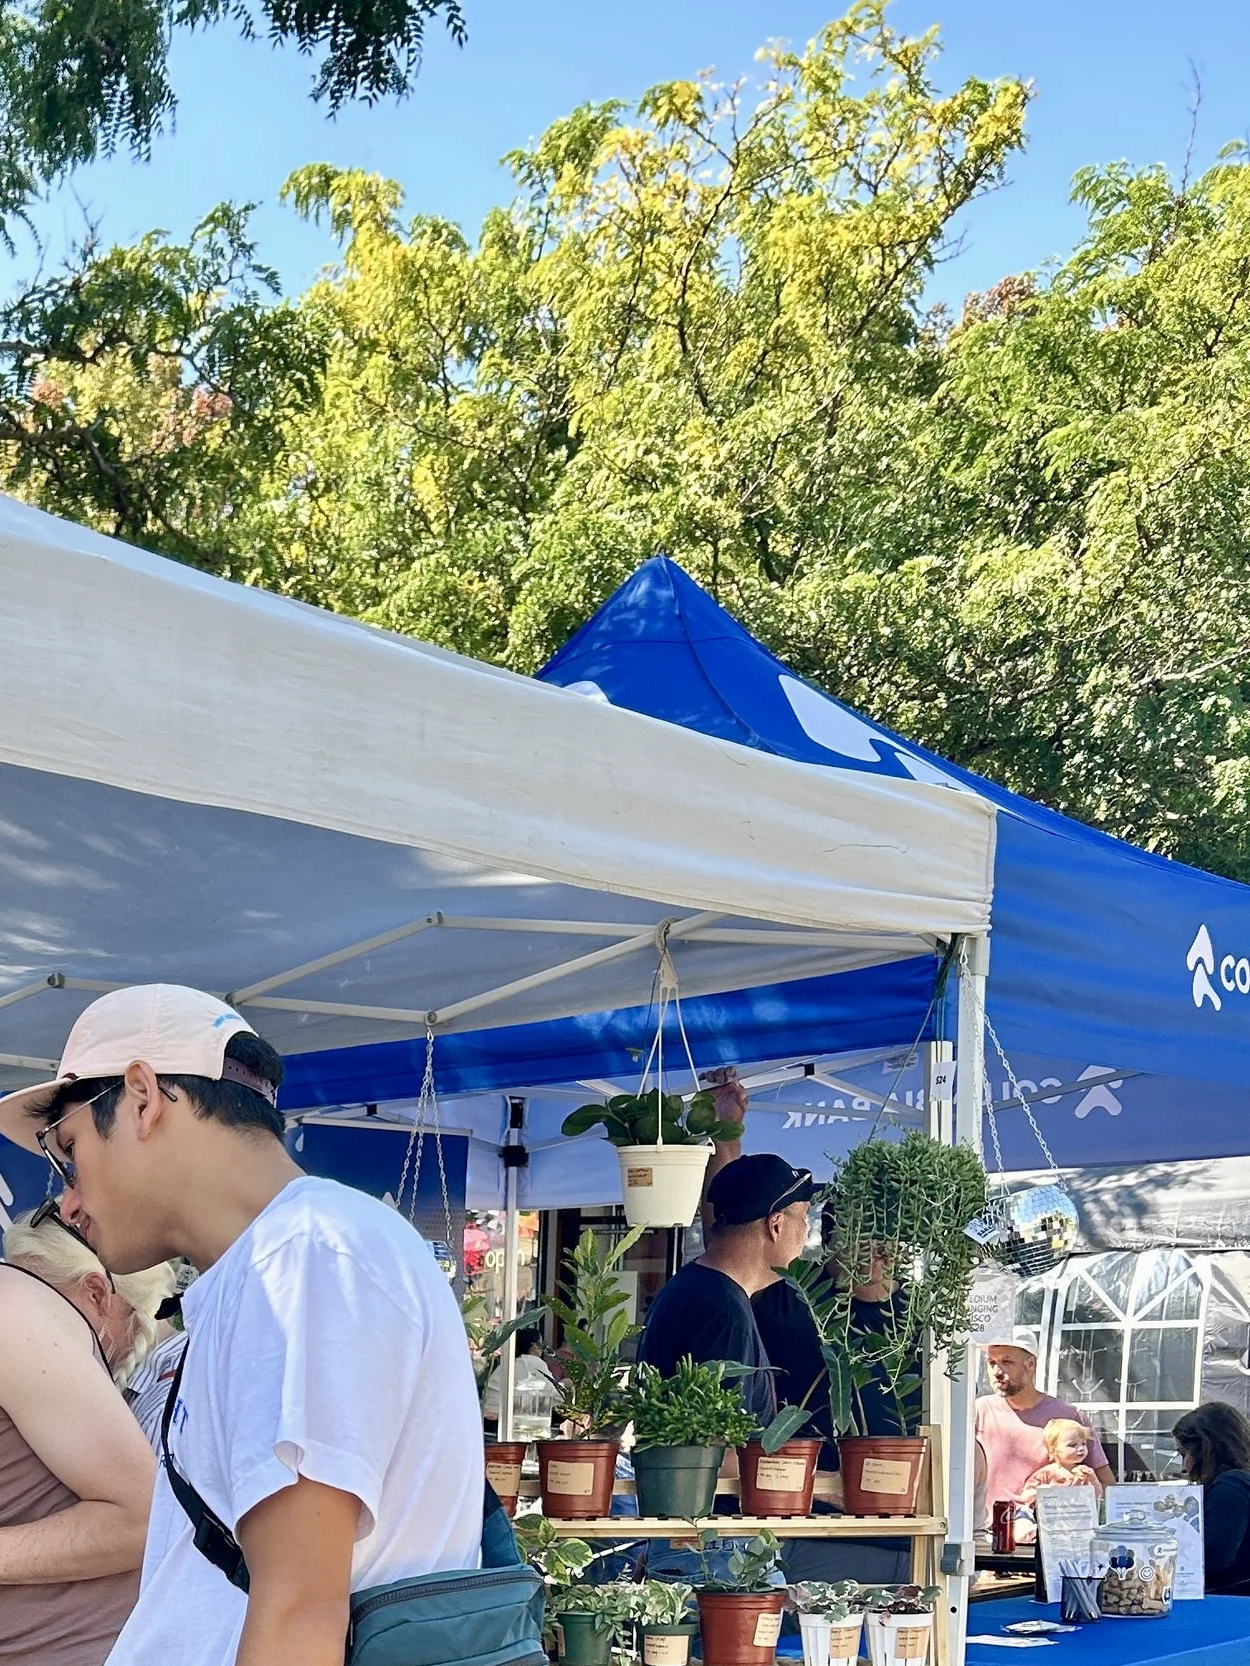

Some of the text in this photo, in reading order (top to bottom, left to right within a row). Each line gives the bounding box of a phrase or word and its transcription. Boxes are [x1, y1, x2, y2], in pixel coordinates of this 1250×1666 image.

[485, 1248, 525, 1275] opn
[969, 1295, 997, 1303] EDIUM
[971, 1314, 991, 1323] ISCO
